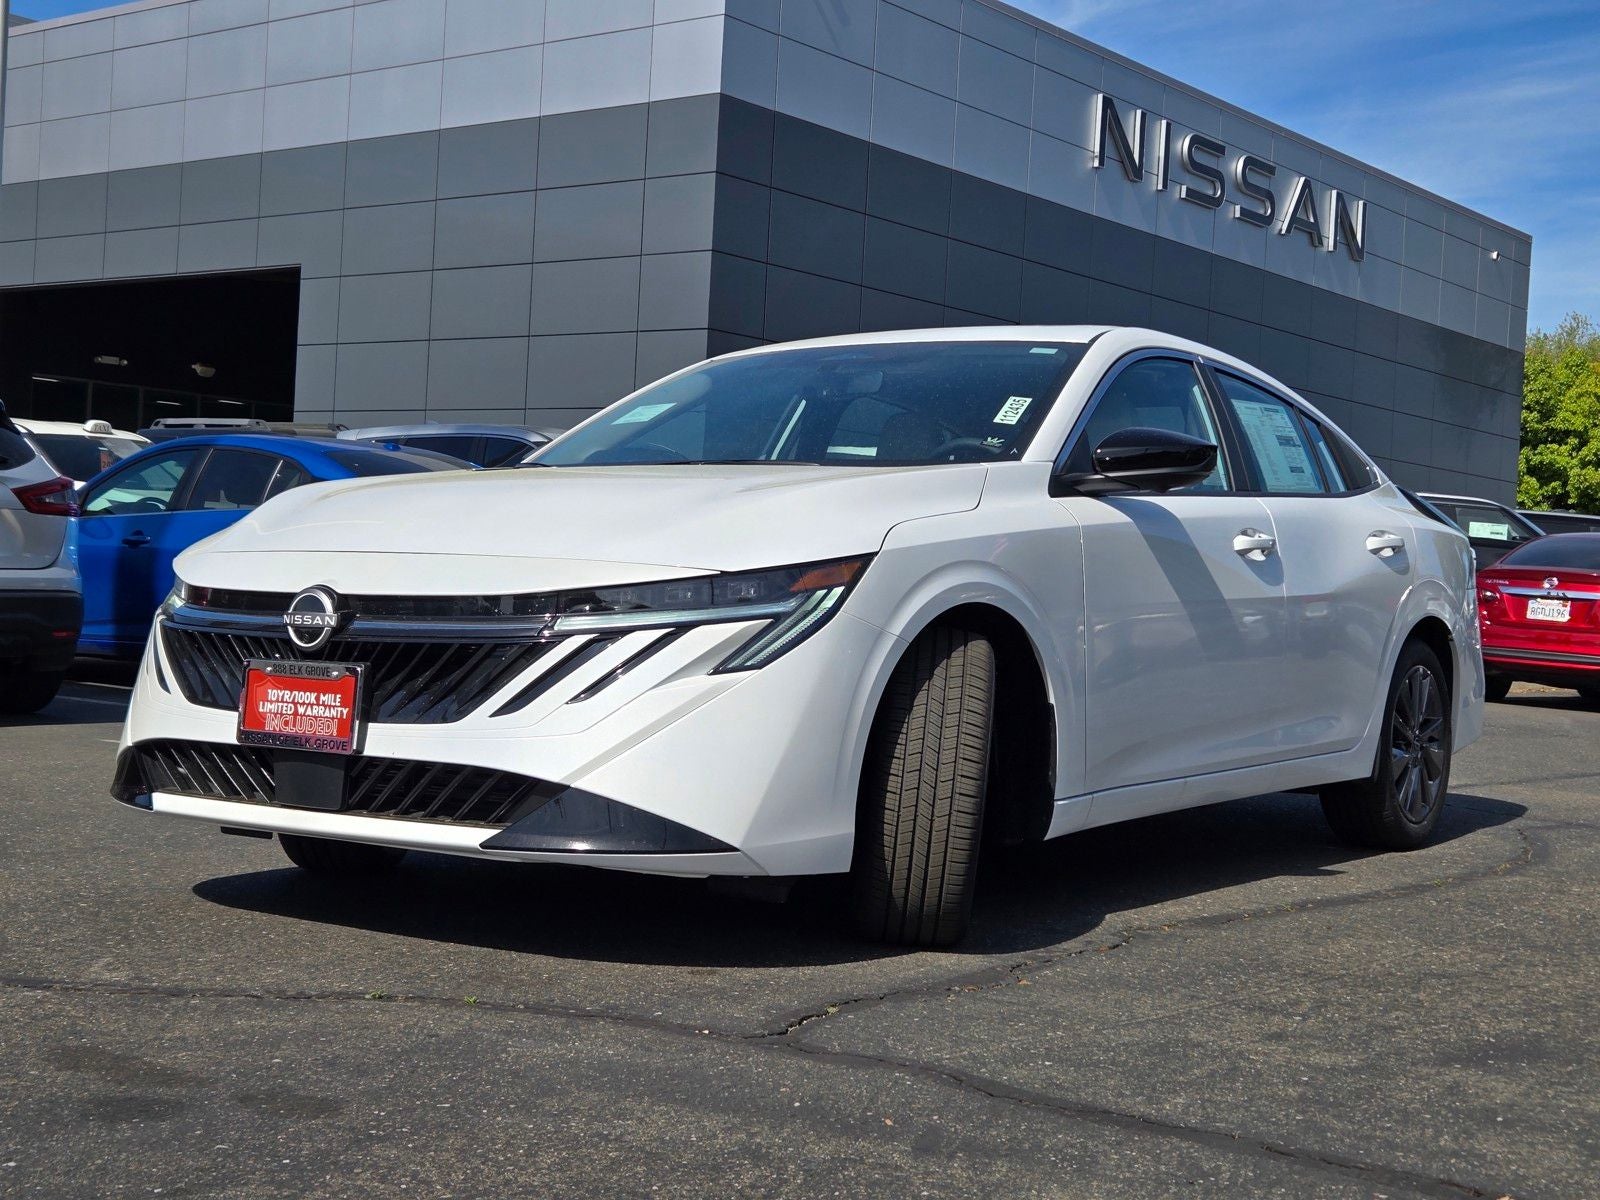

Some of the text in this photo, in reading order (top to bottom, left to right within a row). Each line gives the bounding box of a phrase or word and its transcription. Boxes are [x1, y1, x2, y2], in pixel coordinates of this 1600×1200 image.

[1093, 93, 1368, 262] NISSAN
[1000, 398, 1027, 422] 112435
[283, 614, 336, 626] NISSAN
[272, 663, 331, 677] 888 ELK GROVE
[267, 688, 342, 706] 10YR/100K MILE
[258, 701, 350, 719] LIMITED WARRANTY
[265, 713, 339, 736] INCLUDED!
[294, 736, 312, 748] ELK
[314, 738, 349, 751] GROVE
